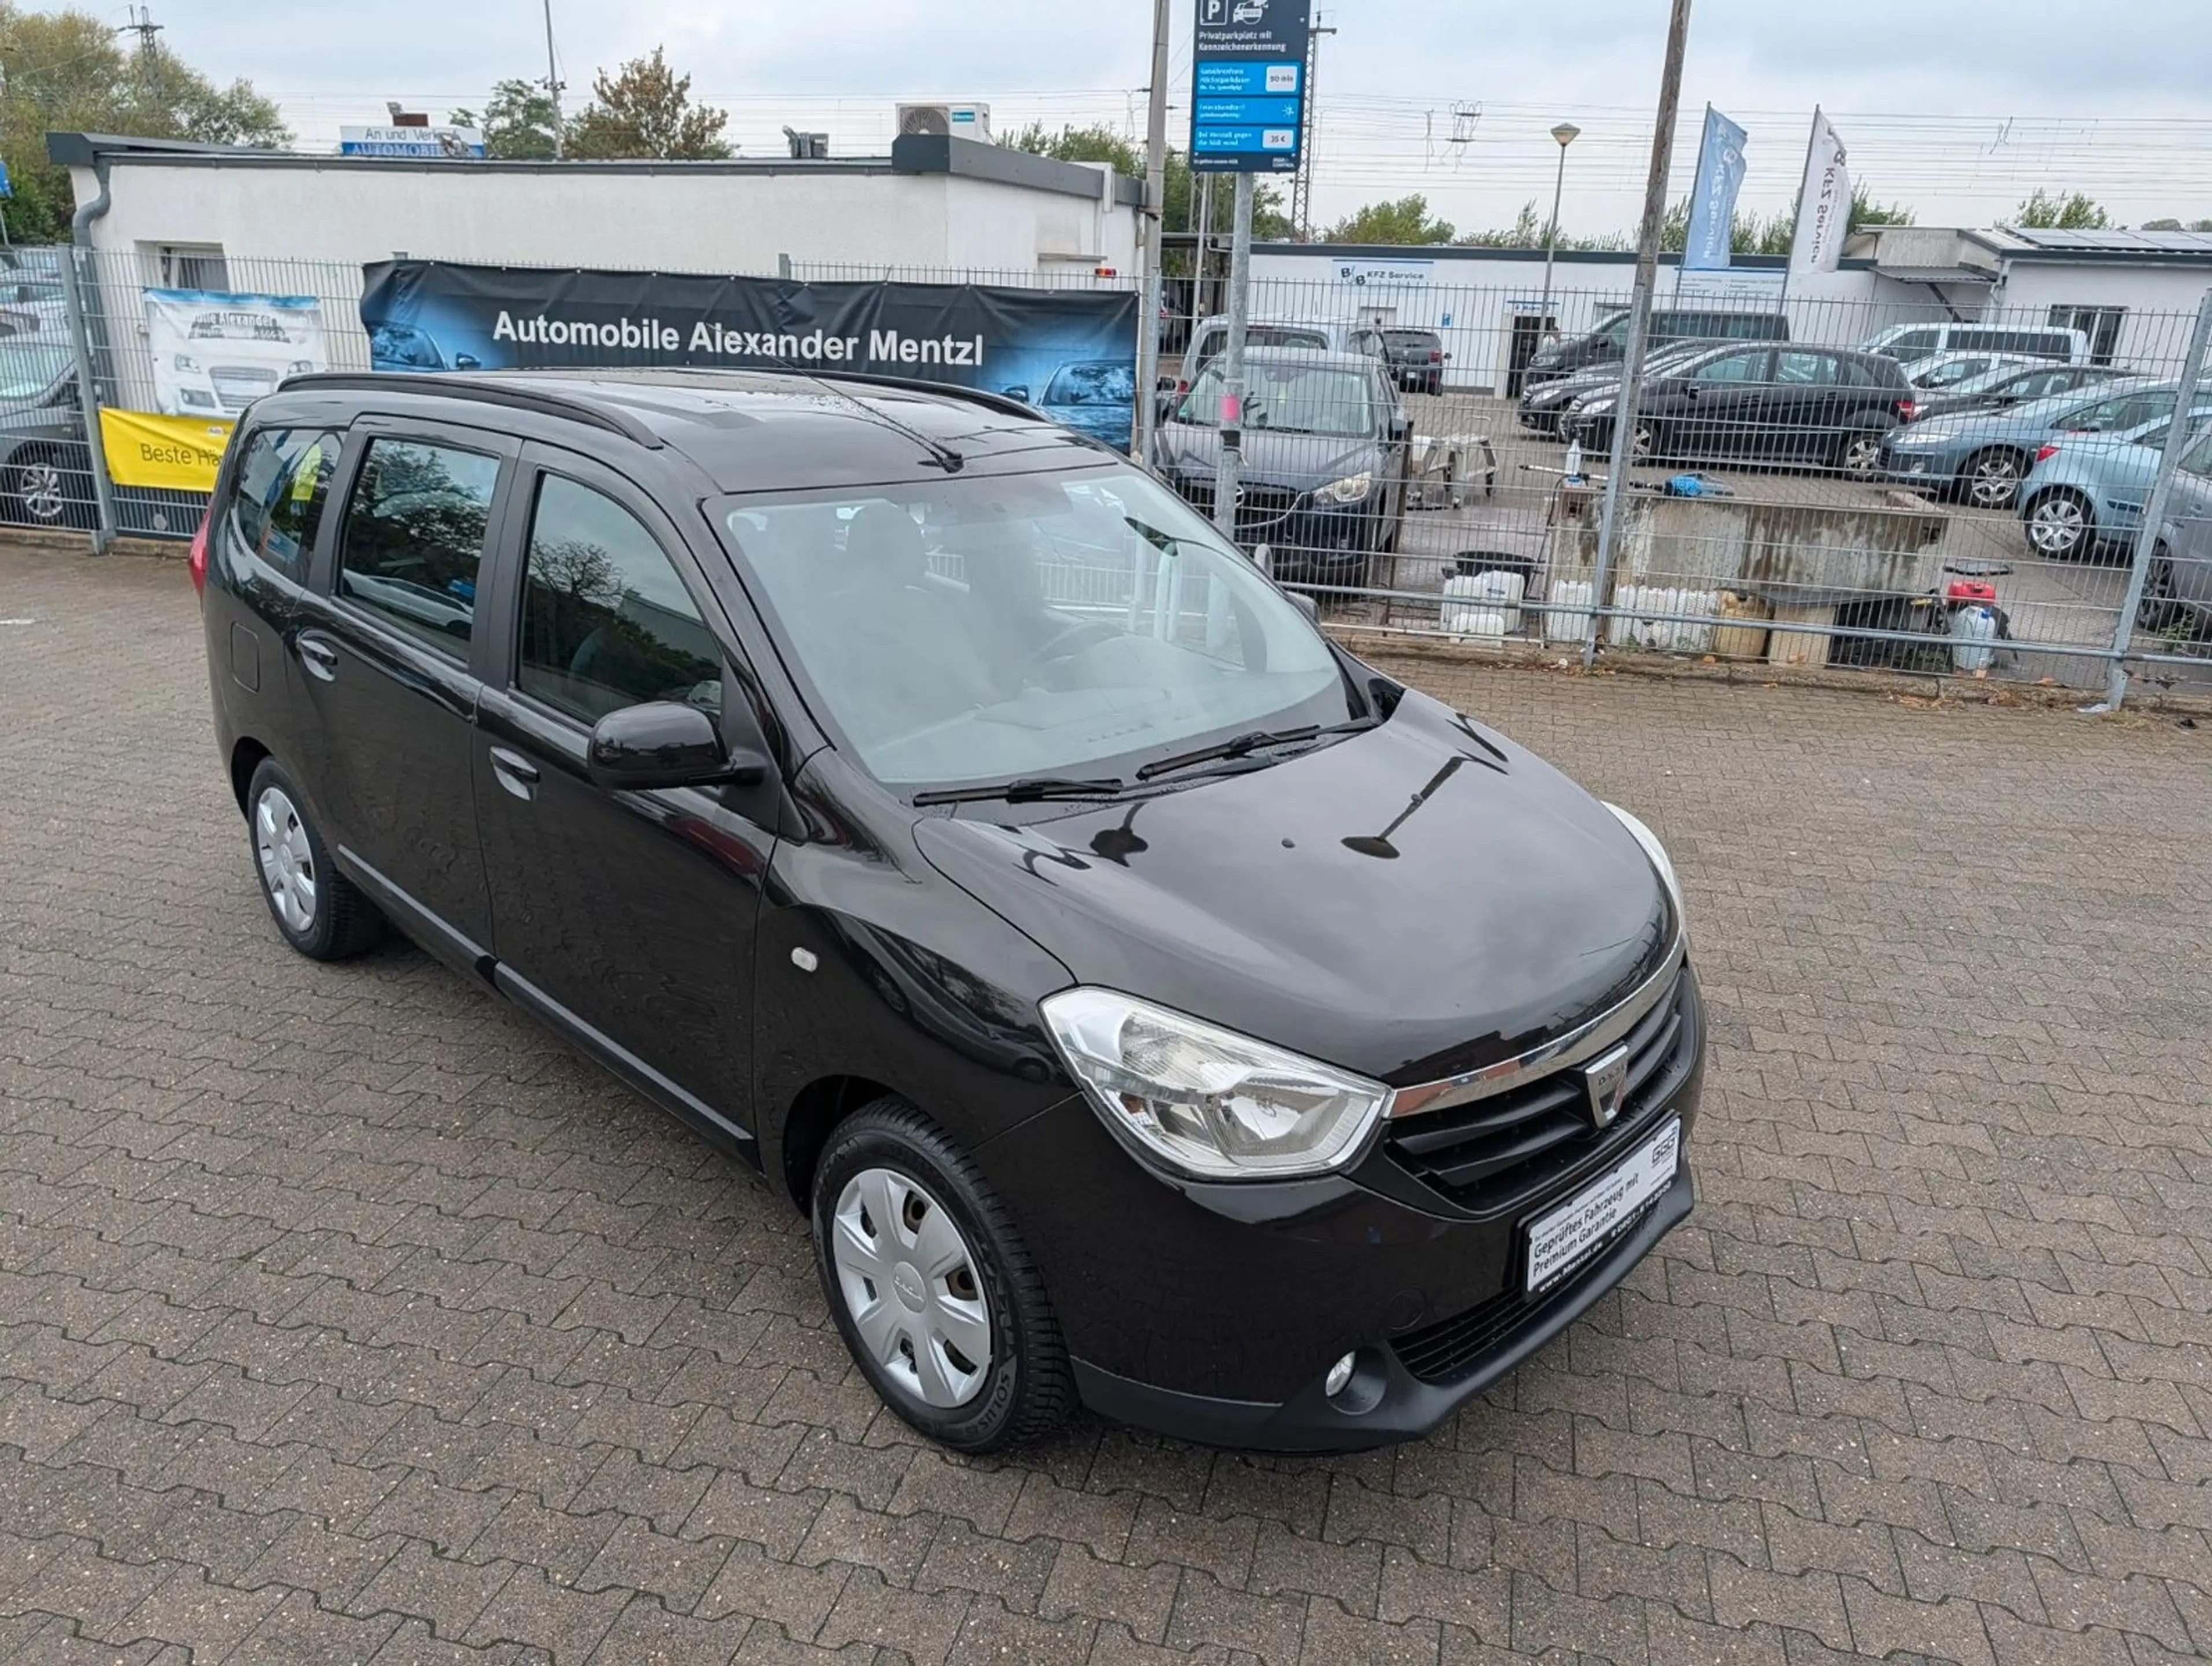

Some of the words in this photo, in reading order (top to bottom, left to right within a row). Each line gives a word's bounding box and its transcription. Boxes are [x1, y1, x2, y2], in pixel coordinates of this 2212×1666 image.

[1208, 0, 1220, 20] P
[1198, 31, 1257, 41] Privatparkplatz
[1259, 30, 1272, 39] mit
[1198, 42, 1286, 52] Kennzeichenerkennung
[366, 128, 381, 140] An
[386, 129, 406, 140] und
[1367, 270, 1386, 278] KFZ
[1389, 270, 1424, 279] Service
[493, 311, 680, 351] Automobile
[688, 322, 859, 361] Alexander
[869, 329, 982, 366] Mentzl
[140, 443, 192, 465] Beste
[195, 448, 224, 467] Hä
[1534, 1217, 1582, 1259] Geprüftes
[1584, 1186, 1624, 1225] Fahrzeug
[1626, 1172, 1639, 1192] mit
[1533, 1238, 1577, 1277] Premium
[1578, 1207, 1617, 1243] Garantie
[978, 1369, 1010, 1429] SOLUS
